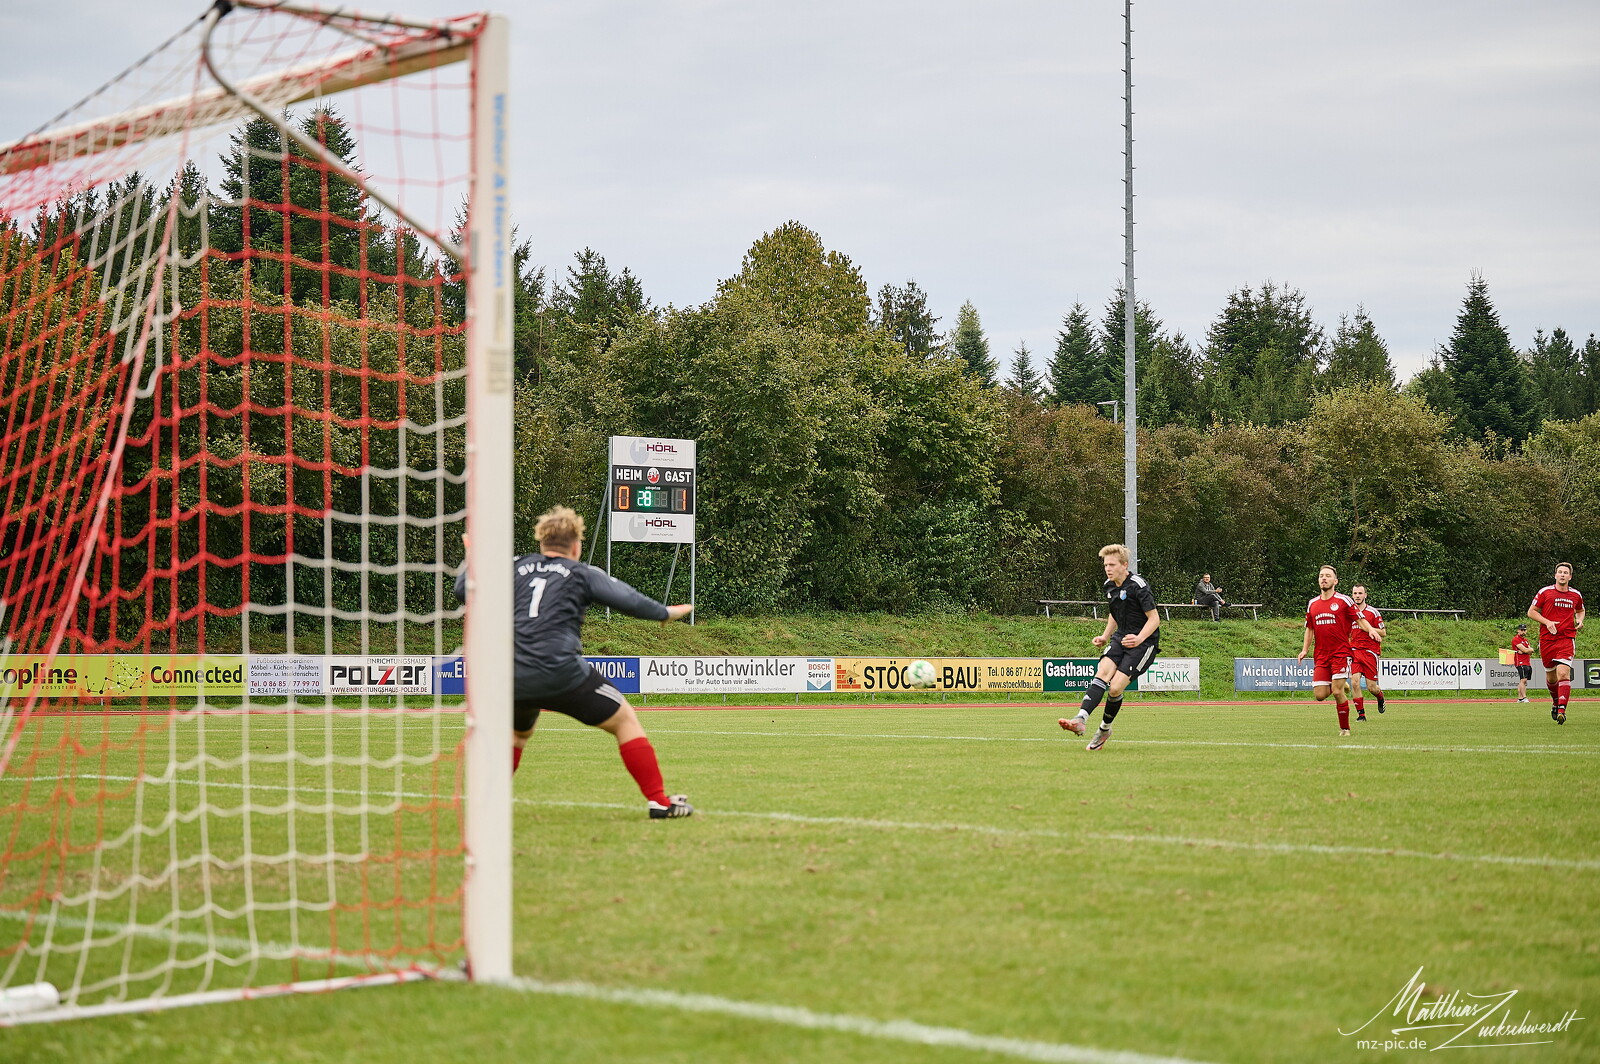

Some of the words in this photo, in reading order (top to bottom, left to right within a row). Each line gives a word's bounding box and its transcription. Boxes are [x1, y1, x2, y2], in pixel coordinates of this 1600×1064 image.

[646, 442, 677, 452] HÖRL
[616, 468, 642, 480] HEIM
[665, 471, 691, 482] GAST
[637, 491, 652, 506] 28
[646, 517, 676, 527] HÖRL
[529, 577, 547, 618] 1
[647, 659, 688, 676] Auto
[694, 659, 796, 676] Buchwinkler
[988, 667, 1000, 676] Tel.
[1000, 667, 1004, 676] 0
[1006, 667, 1014, 676] 86
[1015, 667, 1023, 676] 87
[1028, 667, 1032, 676] 2
[1033, 667, 1041, 676] 22
[1046, 662, 1094, 677] Gasthaus
[1242, 665, 1282, 676] Michael
[1285, 665, 1314, 676] Niede
[1382, 661, 1419, 676] Heizöl
[1423, 661, 1471, 676] Nickolai
[1490, 670, 1519, 678] Braunspe
[863, 661, 978, 689] STÖC-BAU
[1147, 670, 1191, 683] FRANK
[988, 680, 1041, 689] www.stoecklbau.de
